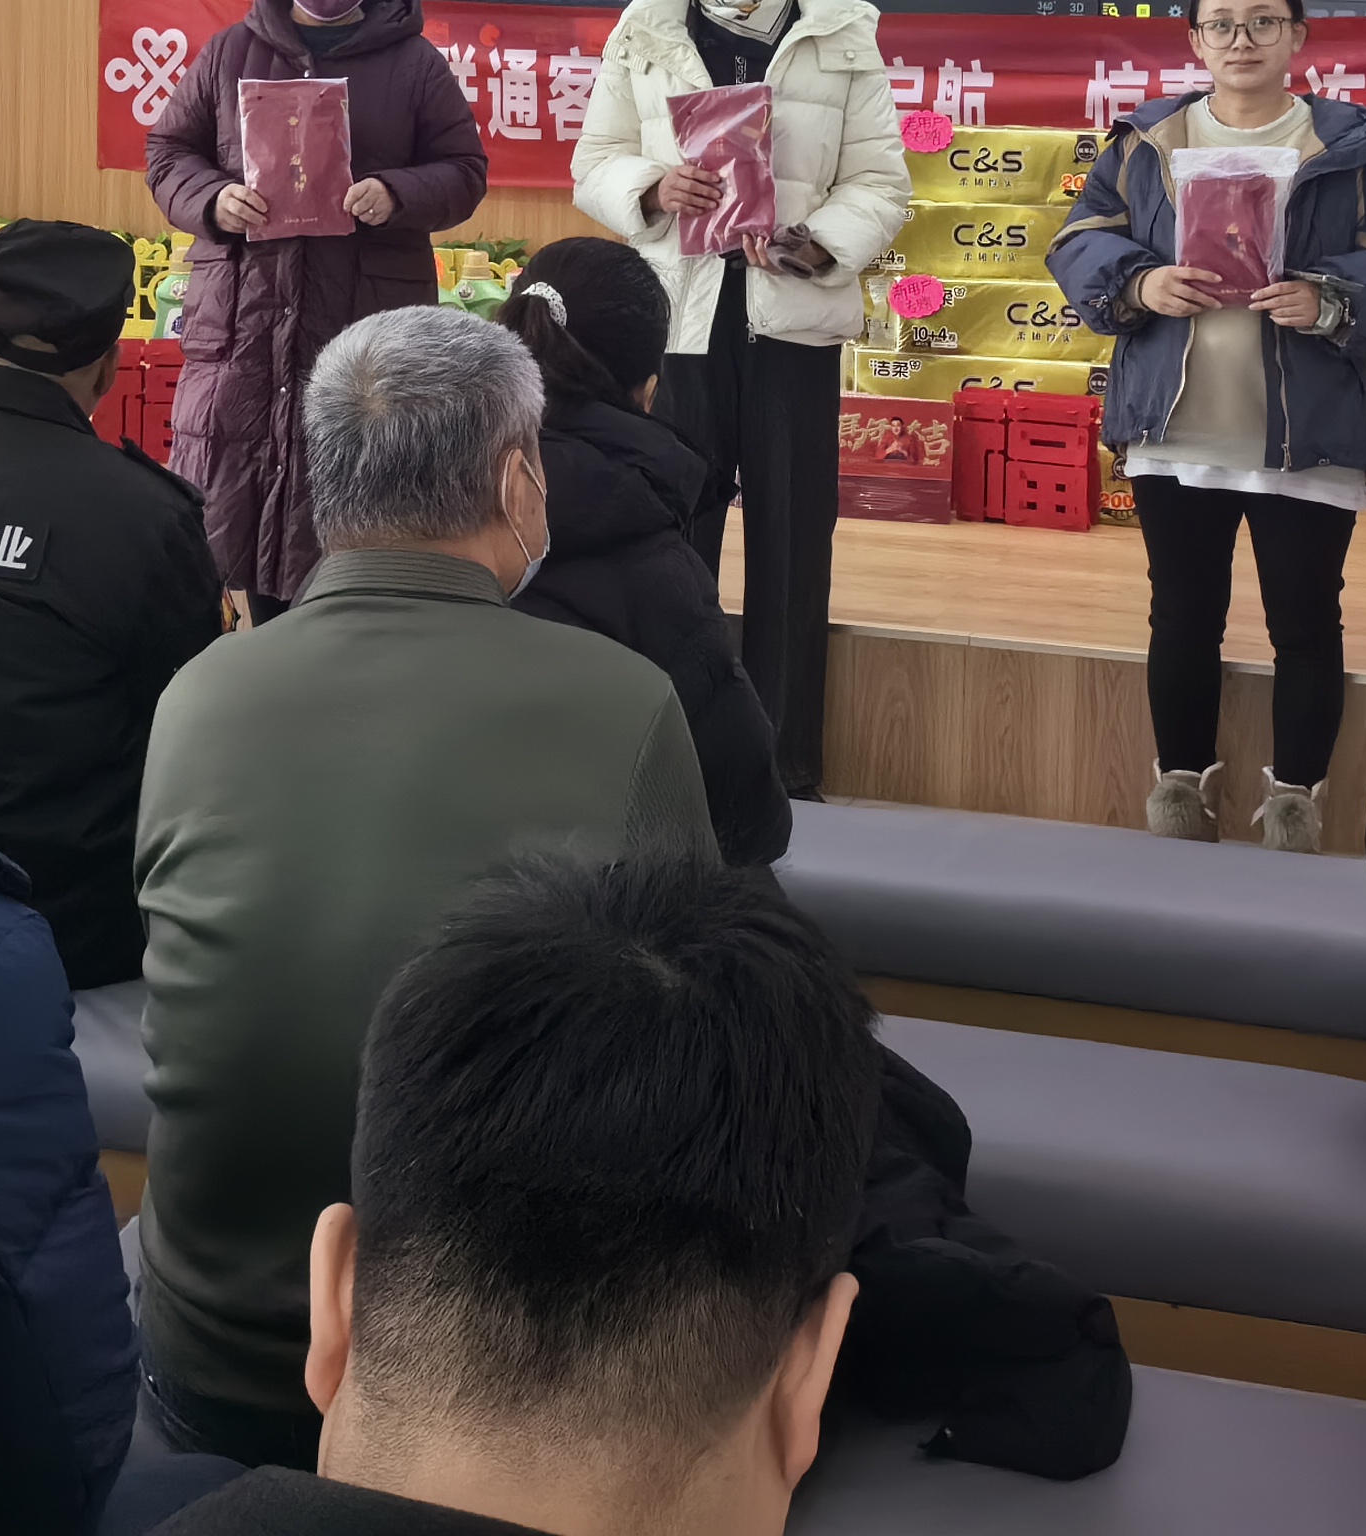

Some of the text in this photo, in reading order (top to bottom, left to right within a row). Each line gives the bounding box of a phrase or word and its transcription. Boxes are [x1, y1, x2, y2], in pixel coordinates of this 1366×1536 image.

[1069, 2, 1084, 13] 3D
[949, 147, 1023, 173] C&S
[953, 222, 1027, 247] C&S
[1006, 301, 1081, 327] C&S
[872, 361, 910, 379] 洁柔
